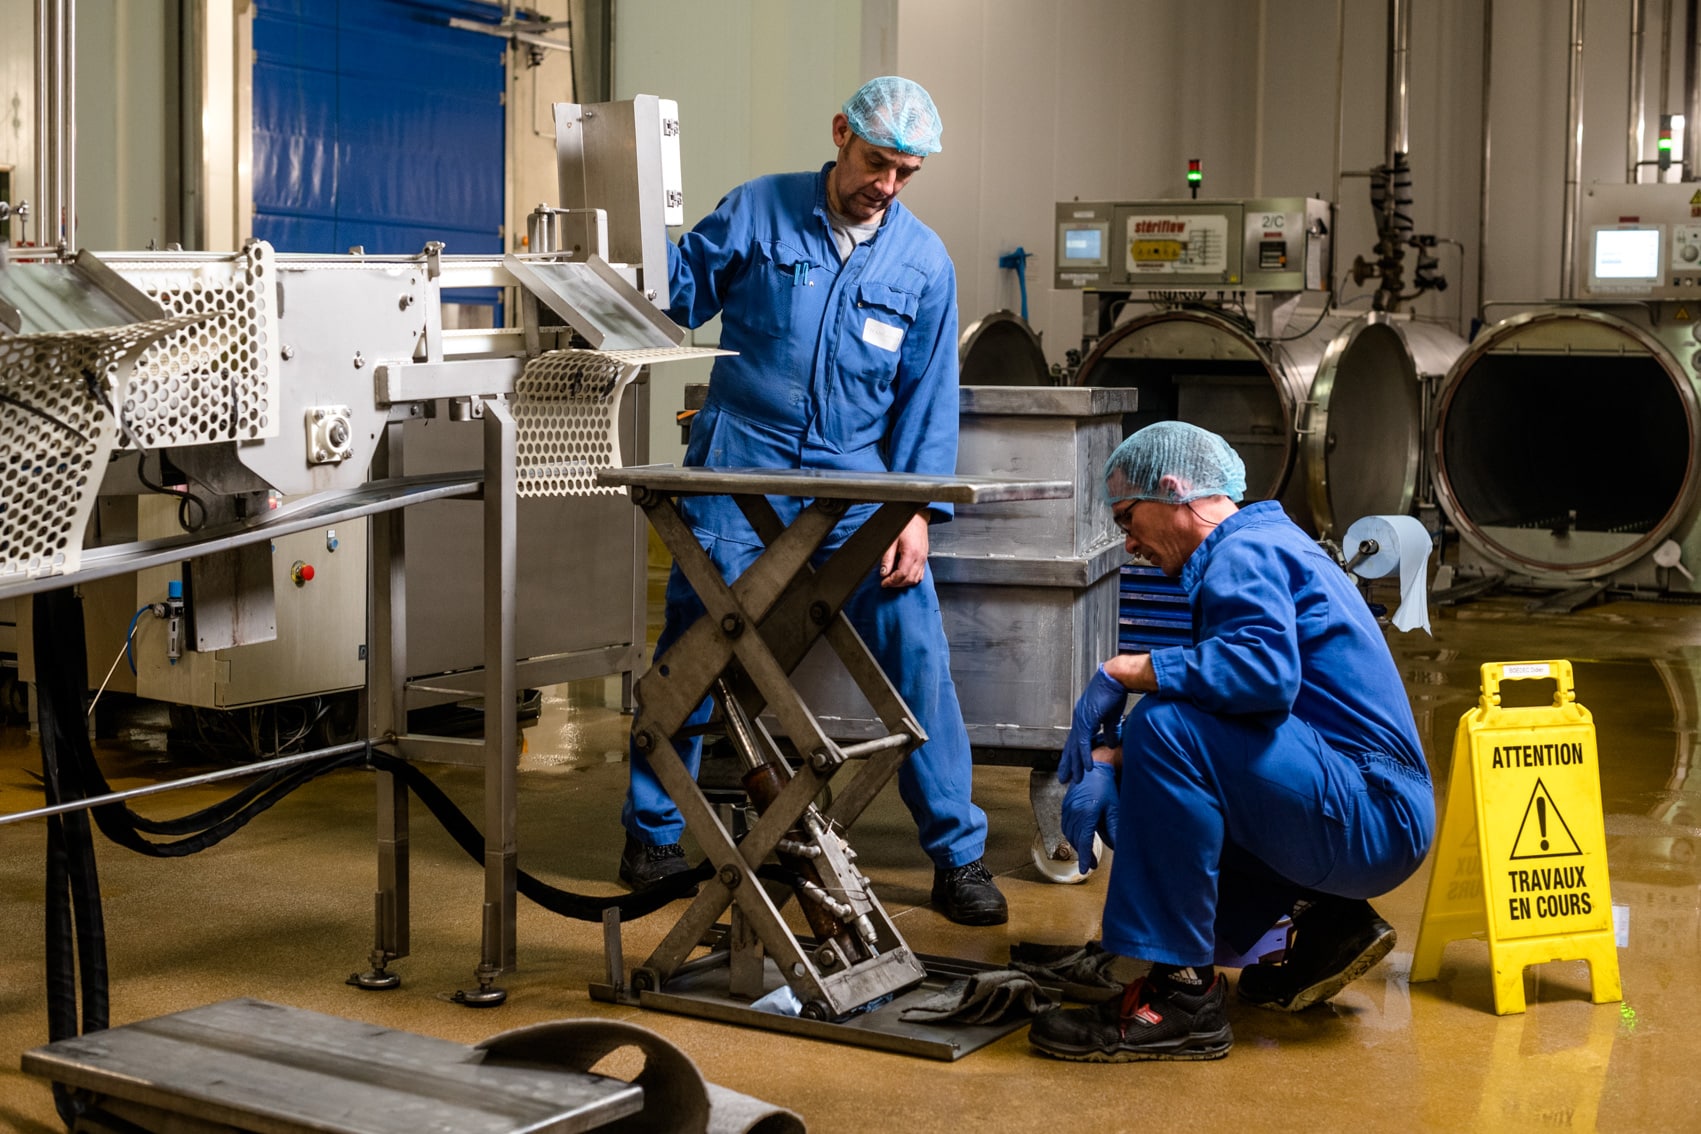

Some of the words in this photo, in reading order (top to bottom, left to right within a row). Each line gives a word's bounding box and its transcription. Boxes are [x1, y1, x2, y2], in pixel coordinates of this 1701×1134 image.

[1262, 215, 1284, 228] 2/C
[1492, 743, 1583, 769] ATTENTION
[1508, 866, 1587, 893] TRAVAUX
[1509, 897, 1531, 920] EN
[1536, 892, 1592, 919] COURS
